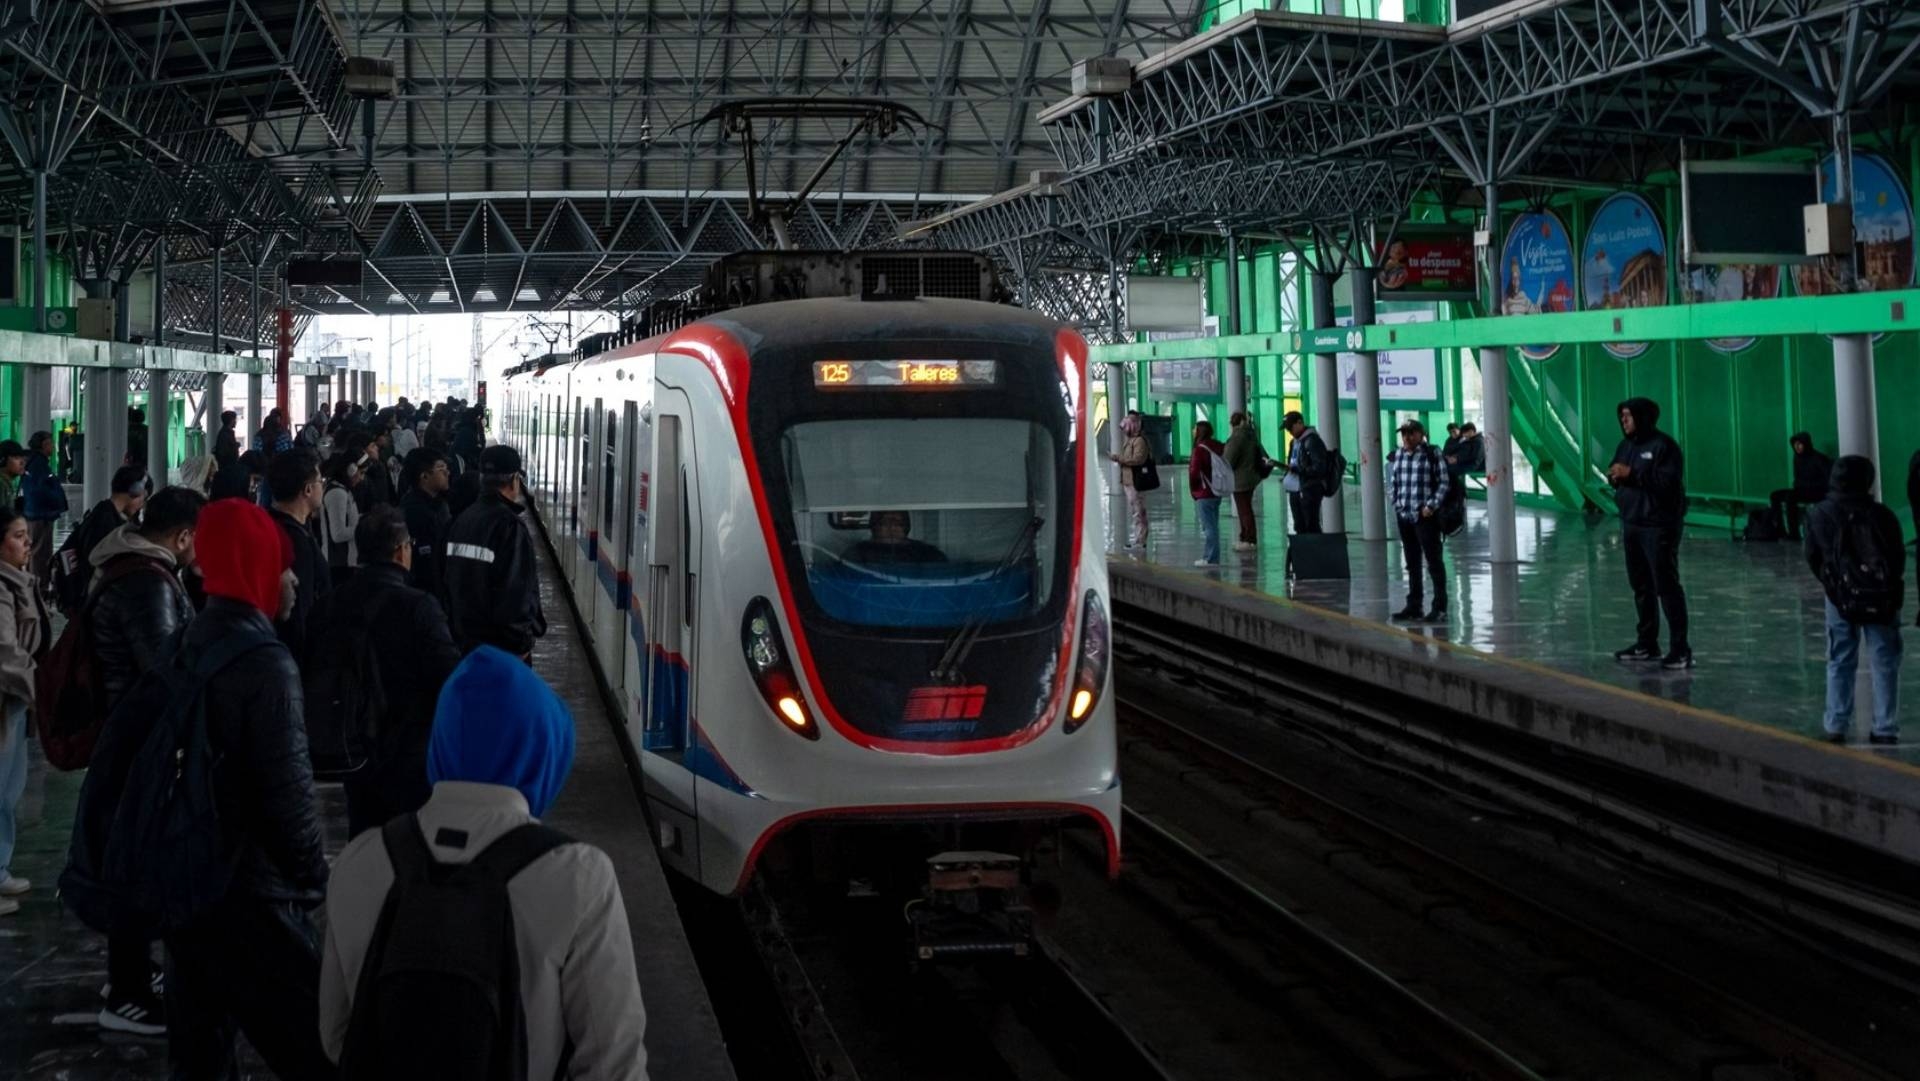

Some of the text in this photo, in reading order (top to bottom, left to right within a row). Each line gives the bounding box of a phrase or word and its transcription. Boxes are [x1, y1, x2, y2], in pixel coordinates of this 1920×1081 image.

[1592, 231, 1608, 243] San
[1608, 229, 1626, 241] Luis
[1521, 238, 1547, 267] Visita
[1408, 257, 1461, 268] tu despensa
[821, 364, 959, 382] 125 Talleres
